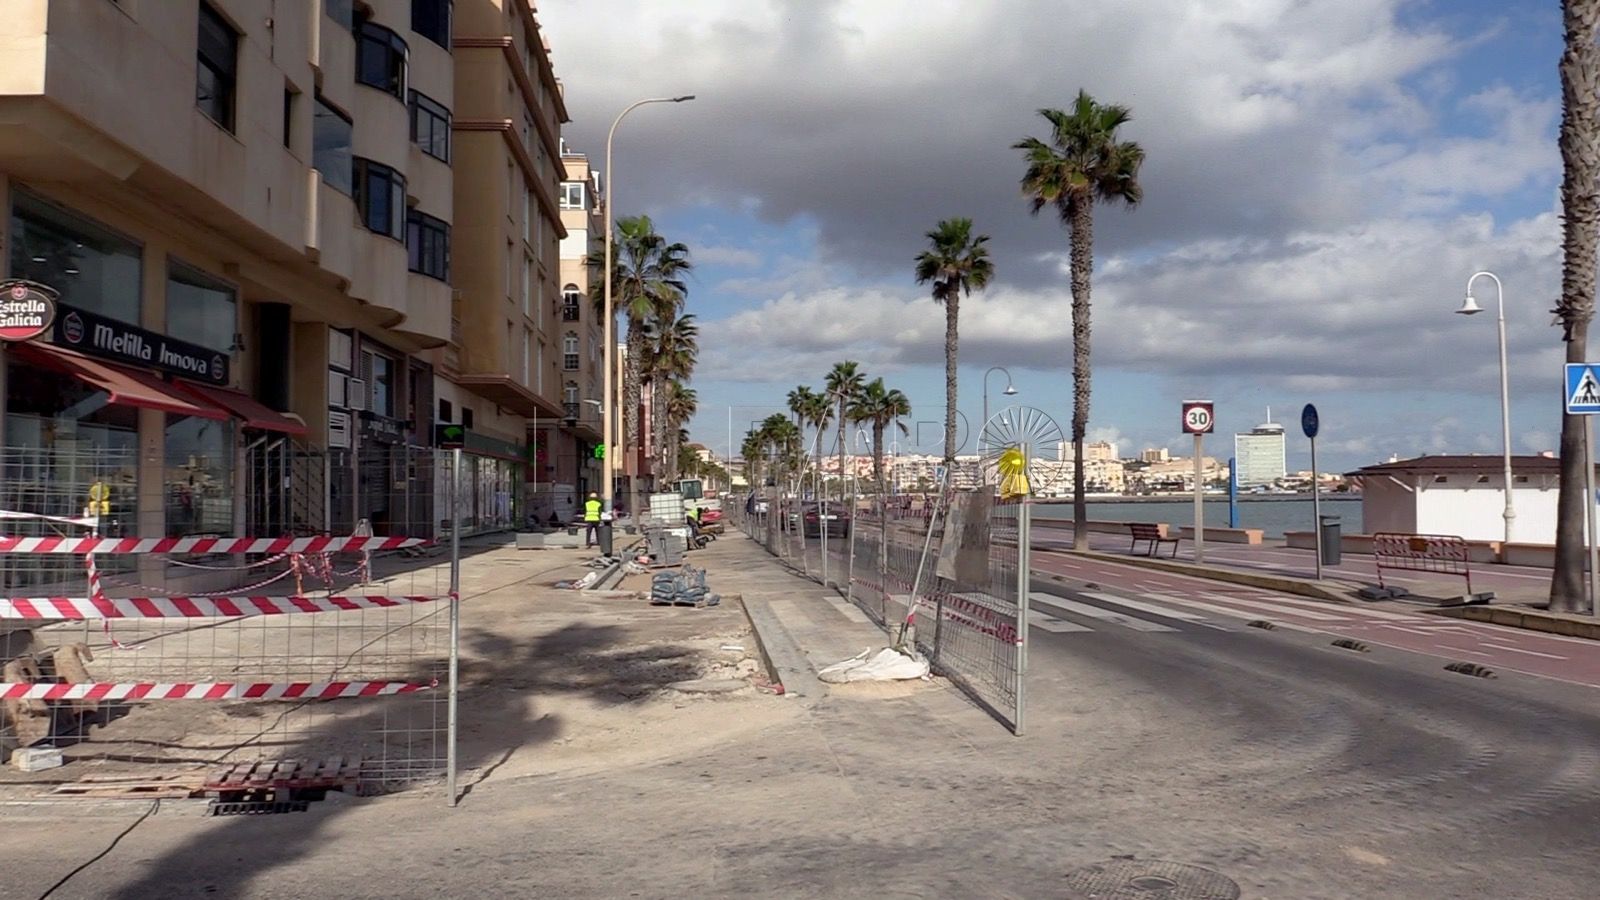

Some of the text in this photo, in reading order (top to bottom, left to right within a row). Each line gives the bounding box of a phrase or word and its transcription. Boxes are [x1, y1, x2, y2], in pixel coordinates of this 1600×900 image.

[0, 312, 42, 327] Galicia
[94, 323, 152, 360] Melilla
[160, 342, 207, 374] Innova
[1189, 411, 1208, 425] 30
